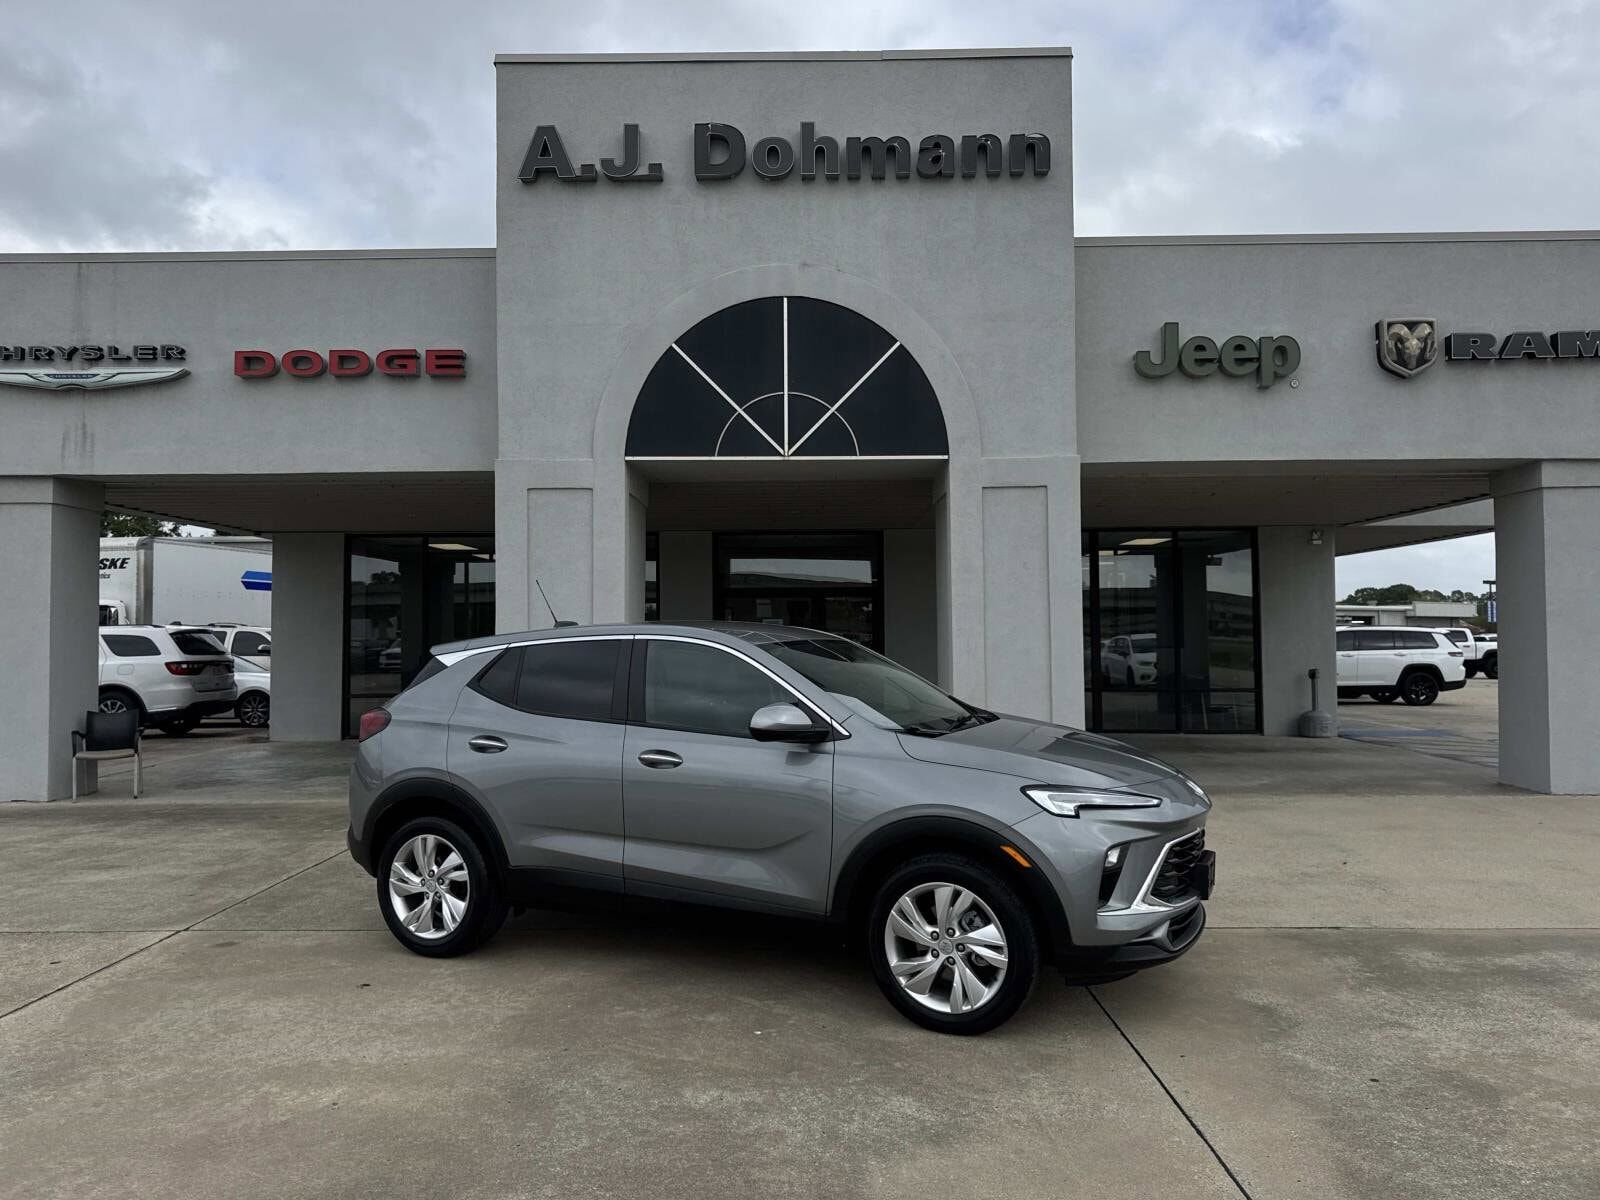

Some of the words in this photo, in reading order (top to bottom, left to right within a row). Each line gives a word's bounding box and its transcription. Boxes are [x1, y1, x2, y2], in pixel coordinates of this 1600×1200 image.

[517, 124, 663, 182] A.J.
[694, 122, 1050, 181] Dohmann
[234, 349, 466, 378] DODGE
[1134, 322, 1301, 389] Jeep
[1446, 330, 1600, 360] RAM
